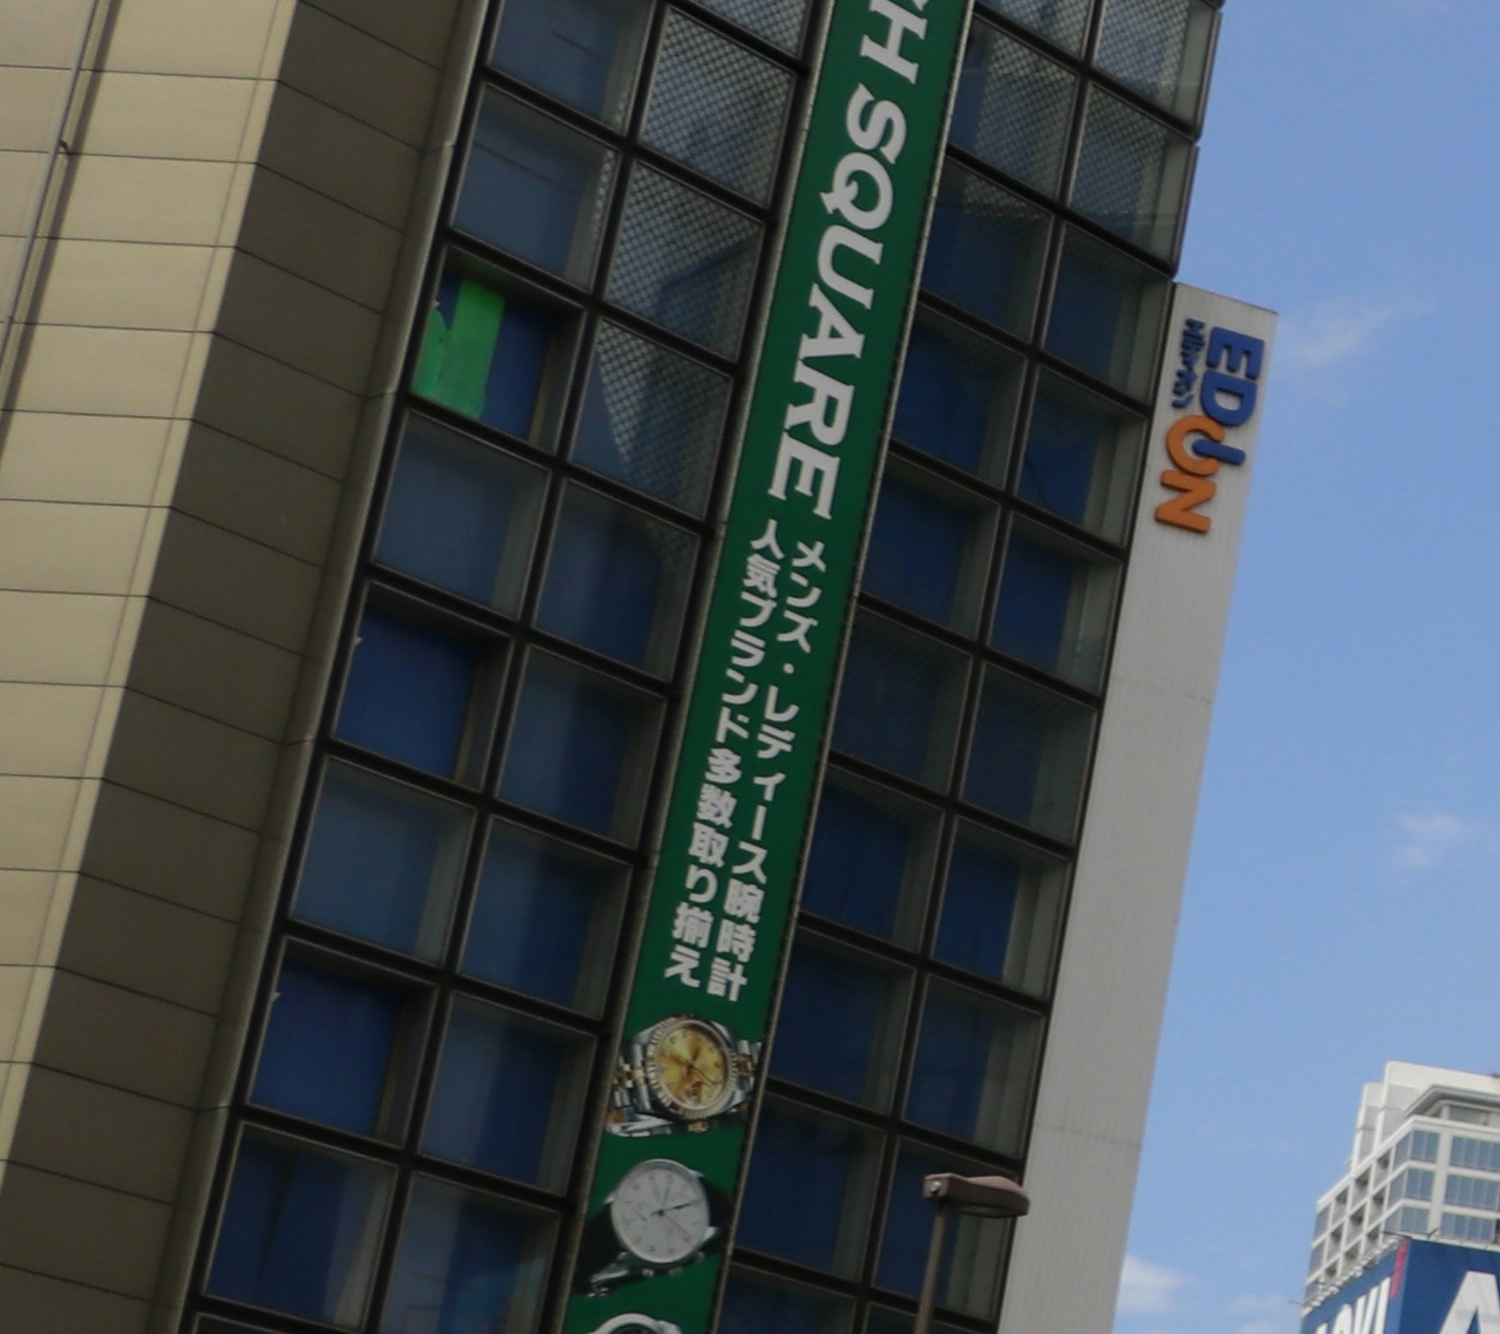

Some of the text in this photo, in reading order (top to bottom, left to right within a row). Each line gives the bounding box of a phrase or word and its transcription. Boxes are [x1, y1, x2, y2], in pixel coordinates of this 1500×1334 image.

[768, 92, 907, 520] SQUARE
[1155, 326, 1265, 534] EDION
[664, 519, 786, 990] 人気ブランド多数取り揃え
[708, 540, 827, 1002] メンズ・レディース腕時計
